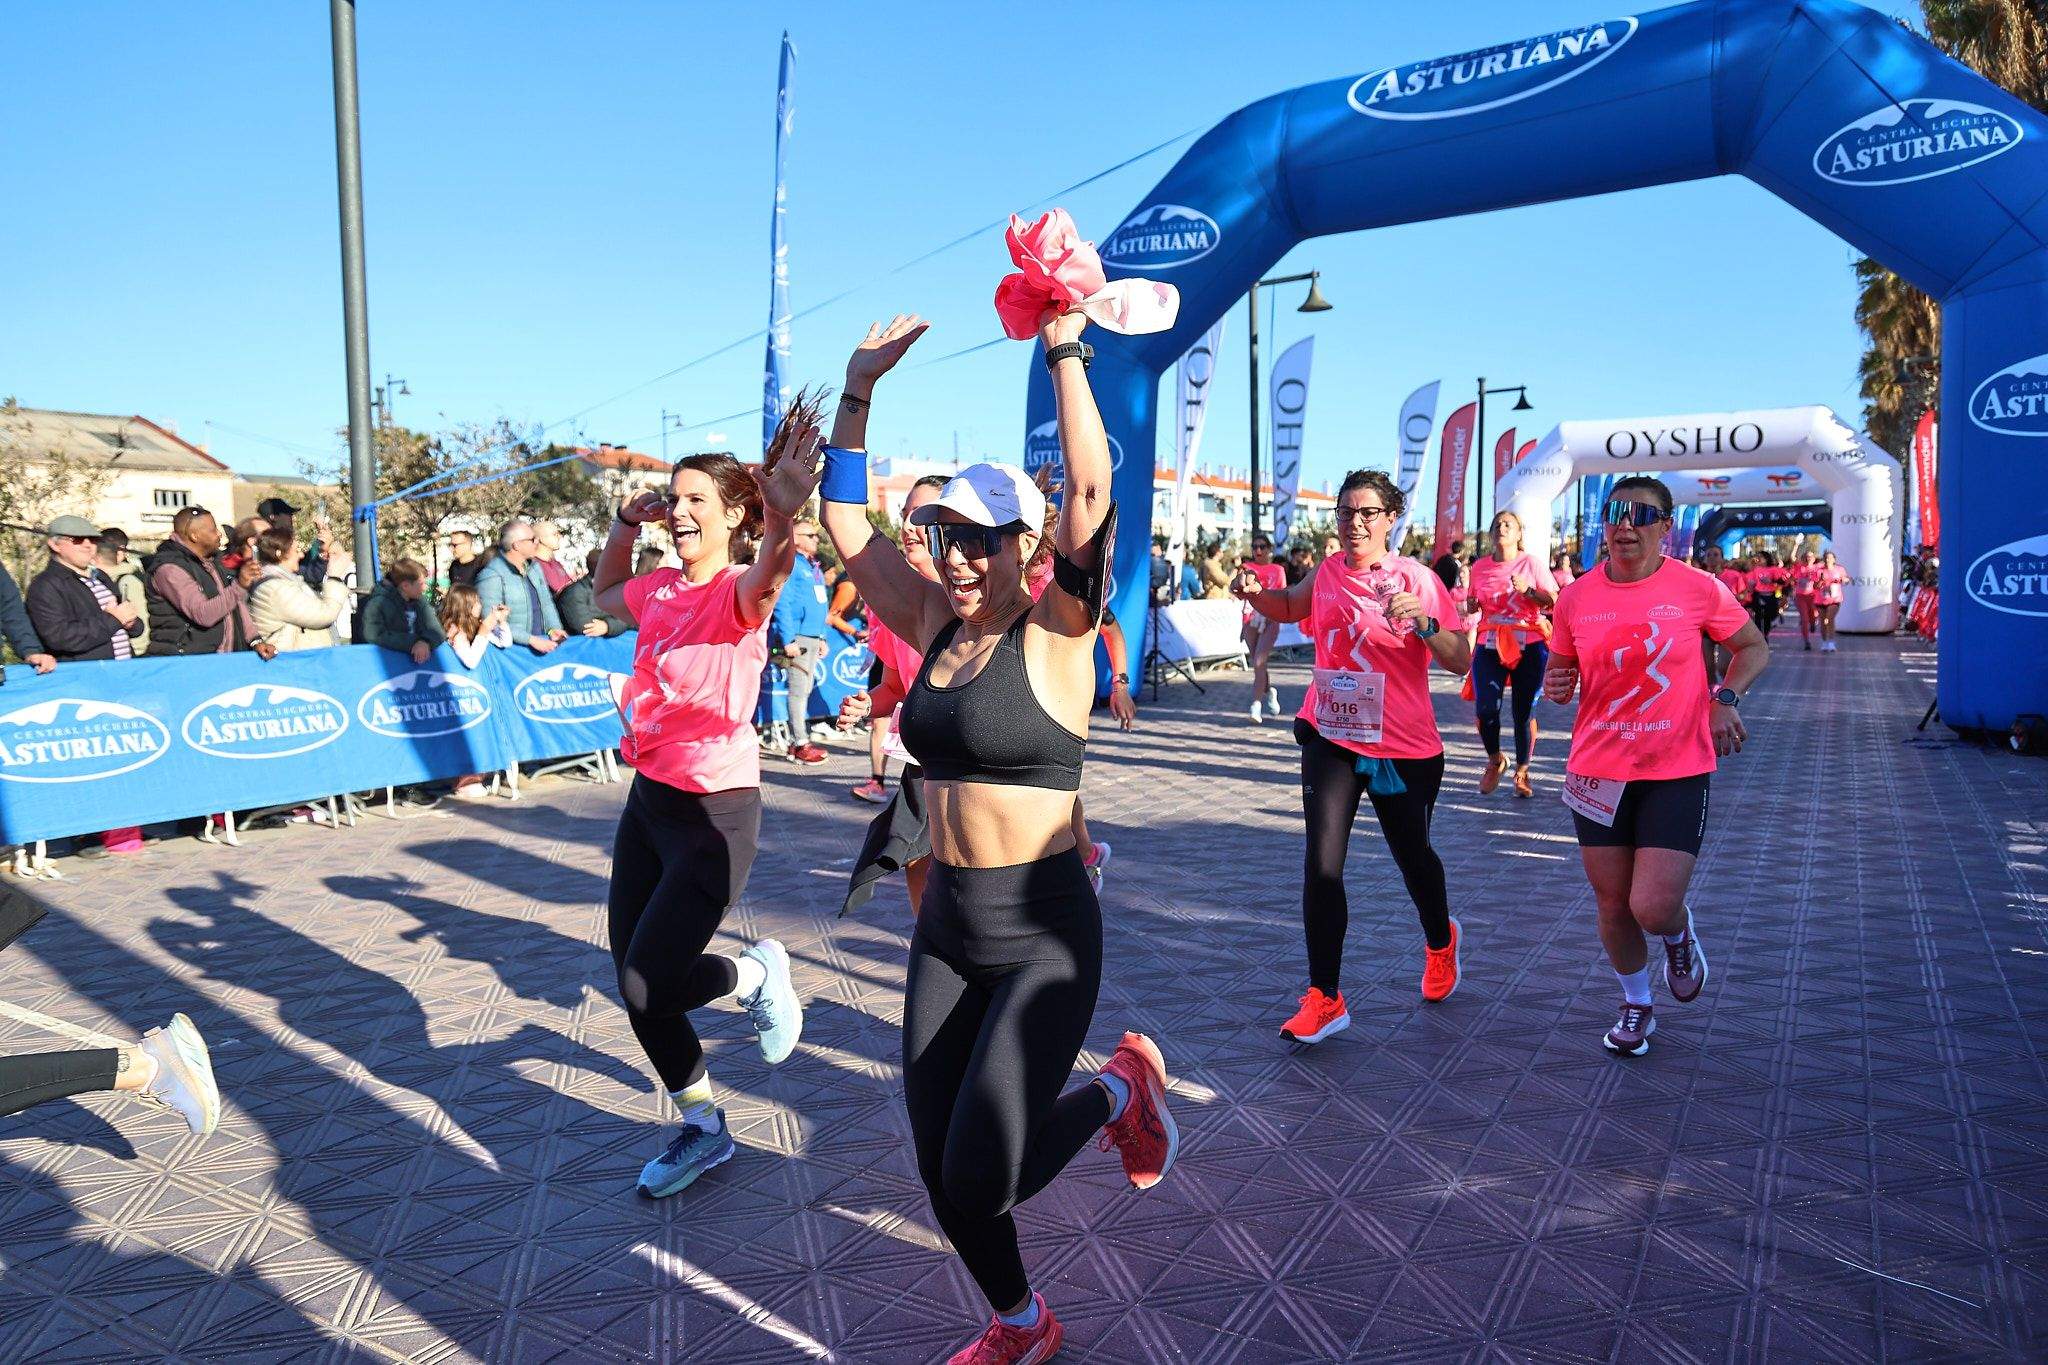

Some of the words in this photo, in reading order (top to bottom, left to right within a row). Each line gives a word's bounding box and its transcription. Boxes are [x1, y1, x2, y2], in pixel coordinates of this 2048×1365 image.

[1365, 27, 1611, 105] ASTURIANA
[1932, 116, 1998, 131] LECHERA
[1830, 126, 2010, 175] ASTURIANA
[1103, 231, 1210, 258] ASTURIANA
[1605, 422, 1764, 459] OYSHO
[1274, 378, 1306, 548] OYSHO
[1848, 576, 1888, 587] YSHO
[370, 696, 484, 725] ASTURIANA
[525, 687, 615, 713] ASTURIAN
[1331, 702, 1358, 715] 016
[199, 712, 339, 745] ASTURIANA
[1620, 722, 1632, 731] DE
[1634, 722, 1643, 732] LA
[1645, 720, 1671, 732] MUJER
